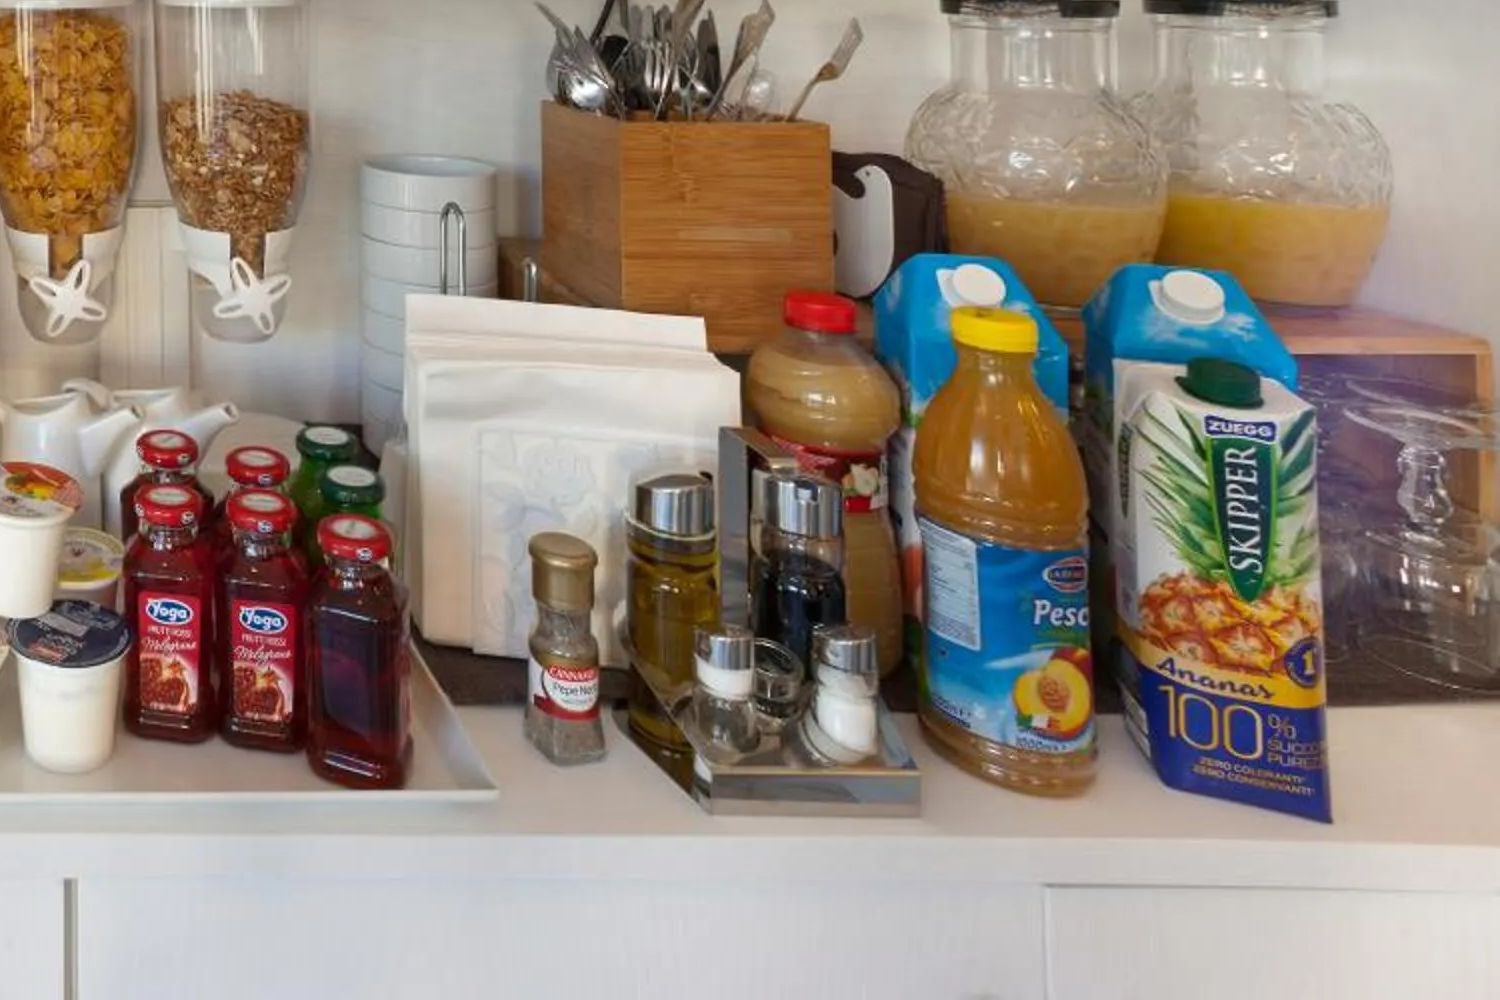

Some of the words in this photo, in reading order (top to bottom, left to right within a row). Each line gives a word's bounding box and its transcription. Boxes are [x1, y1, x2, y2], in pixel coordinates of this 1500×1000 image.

[1207, 419, 1274, 438] ZUEGG
[1223, 446, 1264, 575] SKIPPER
[147, 600, 188, 624] Yoga
[240, 606, 283, 630] Yoga
[1156, 656, 1275, 699] Ananas
